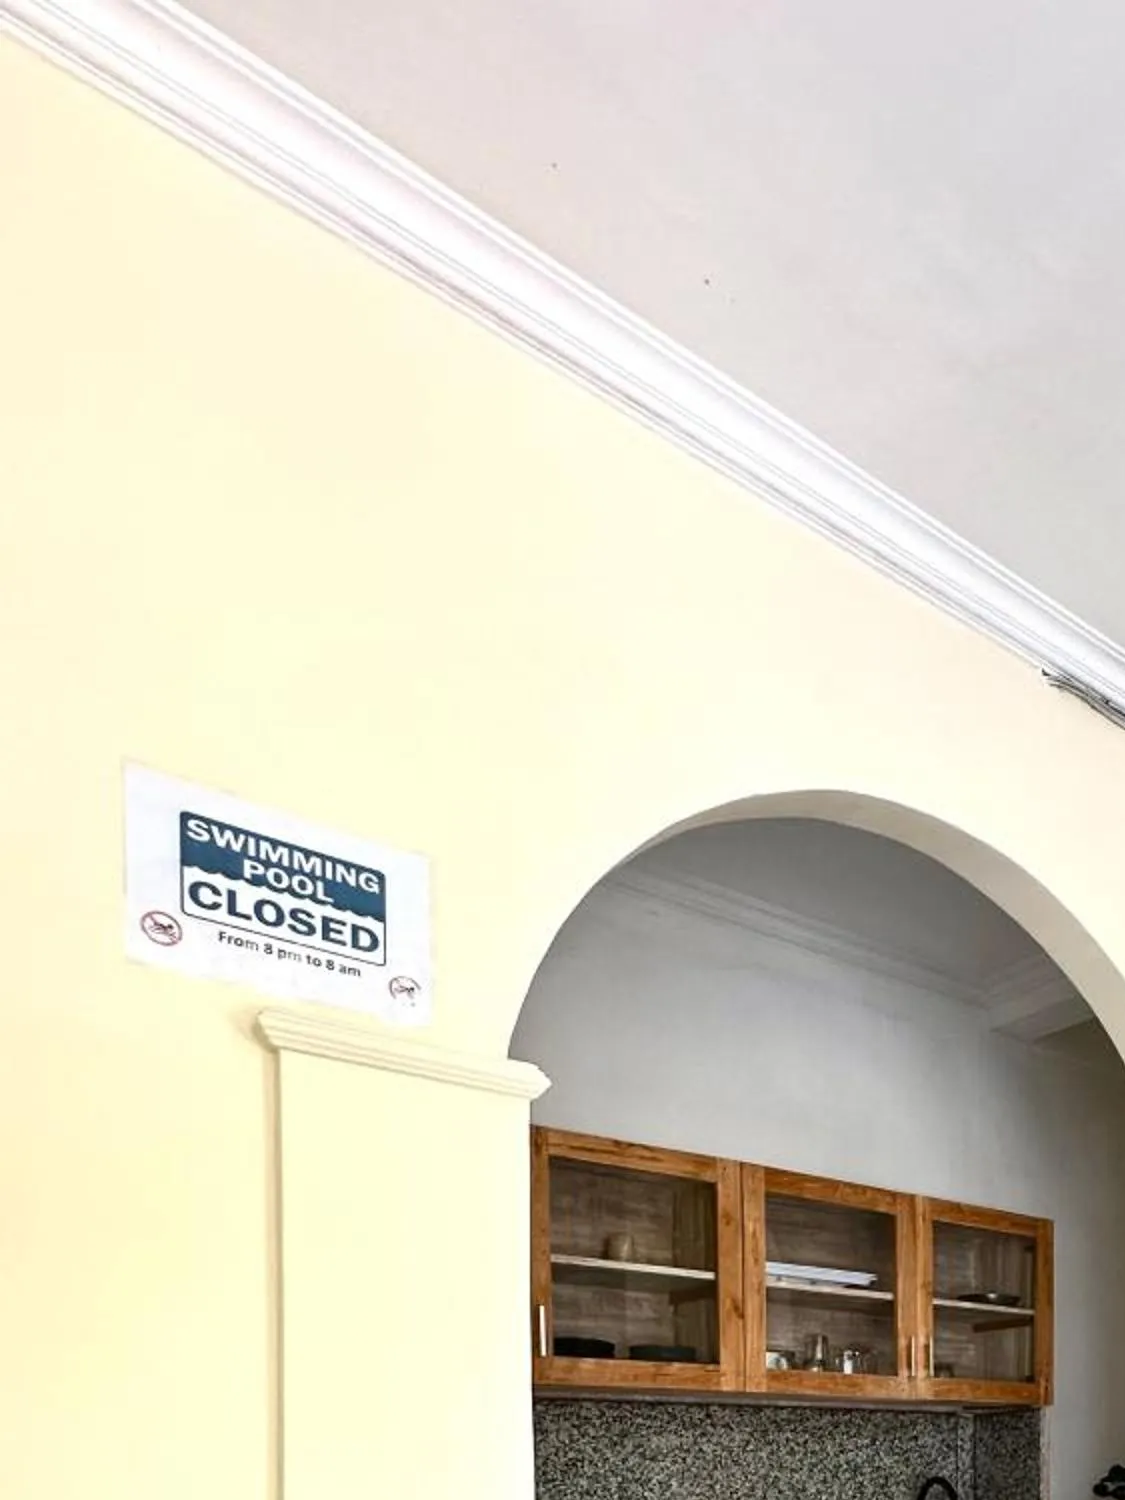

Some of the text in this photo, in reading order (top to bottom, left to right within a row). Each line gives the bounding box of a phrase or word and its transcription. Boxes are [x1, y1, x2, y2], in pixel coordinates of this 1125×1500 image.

[186, 818, 381, 895] SWIMMING
[243, 858, 334, 904] POOL
[188, 880, 380, 952] CLOSED
[218, 930, 361, 977] From 8 pm to 8 am
